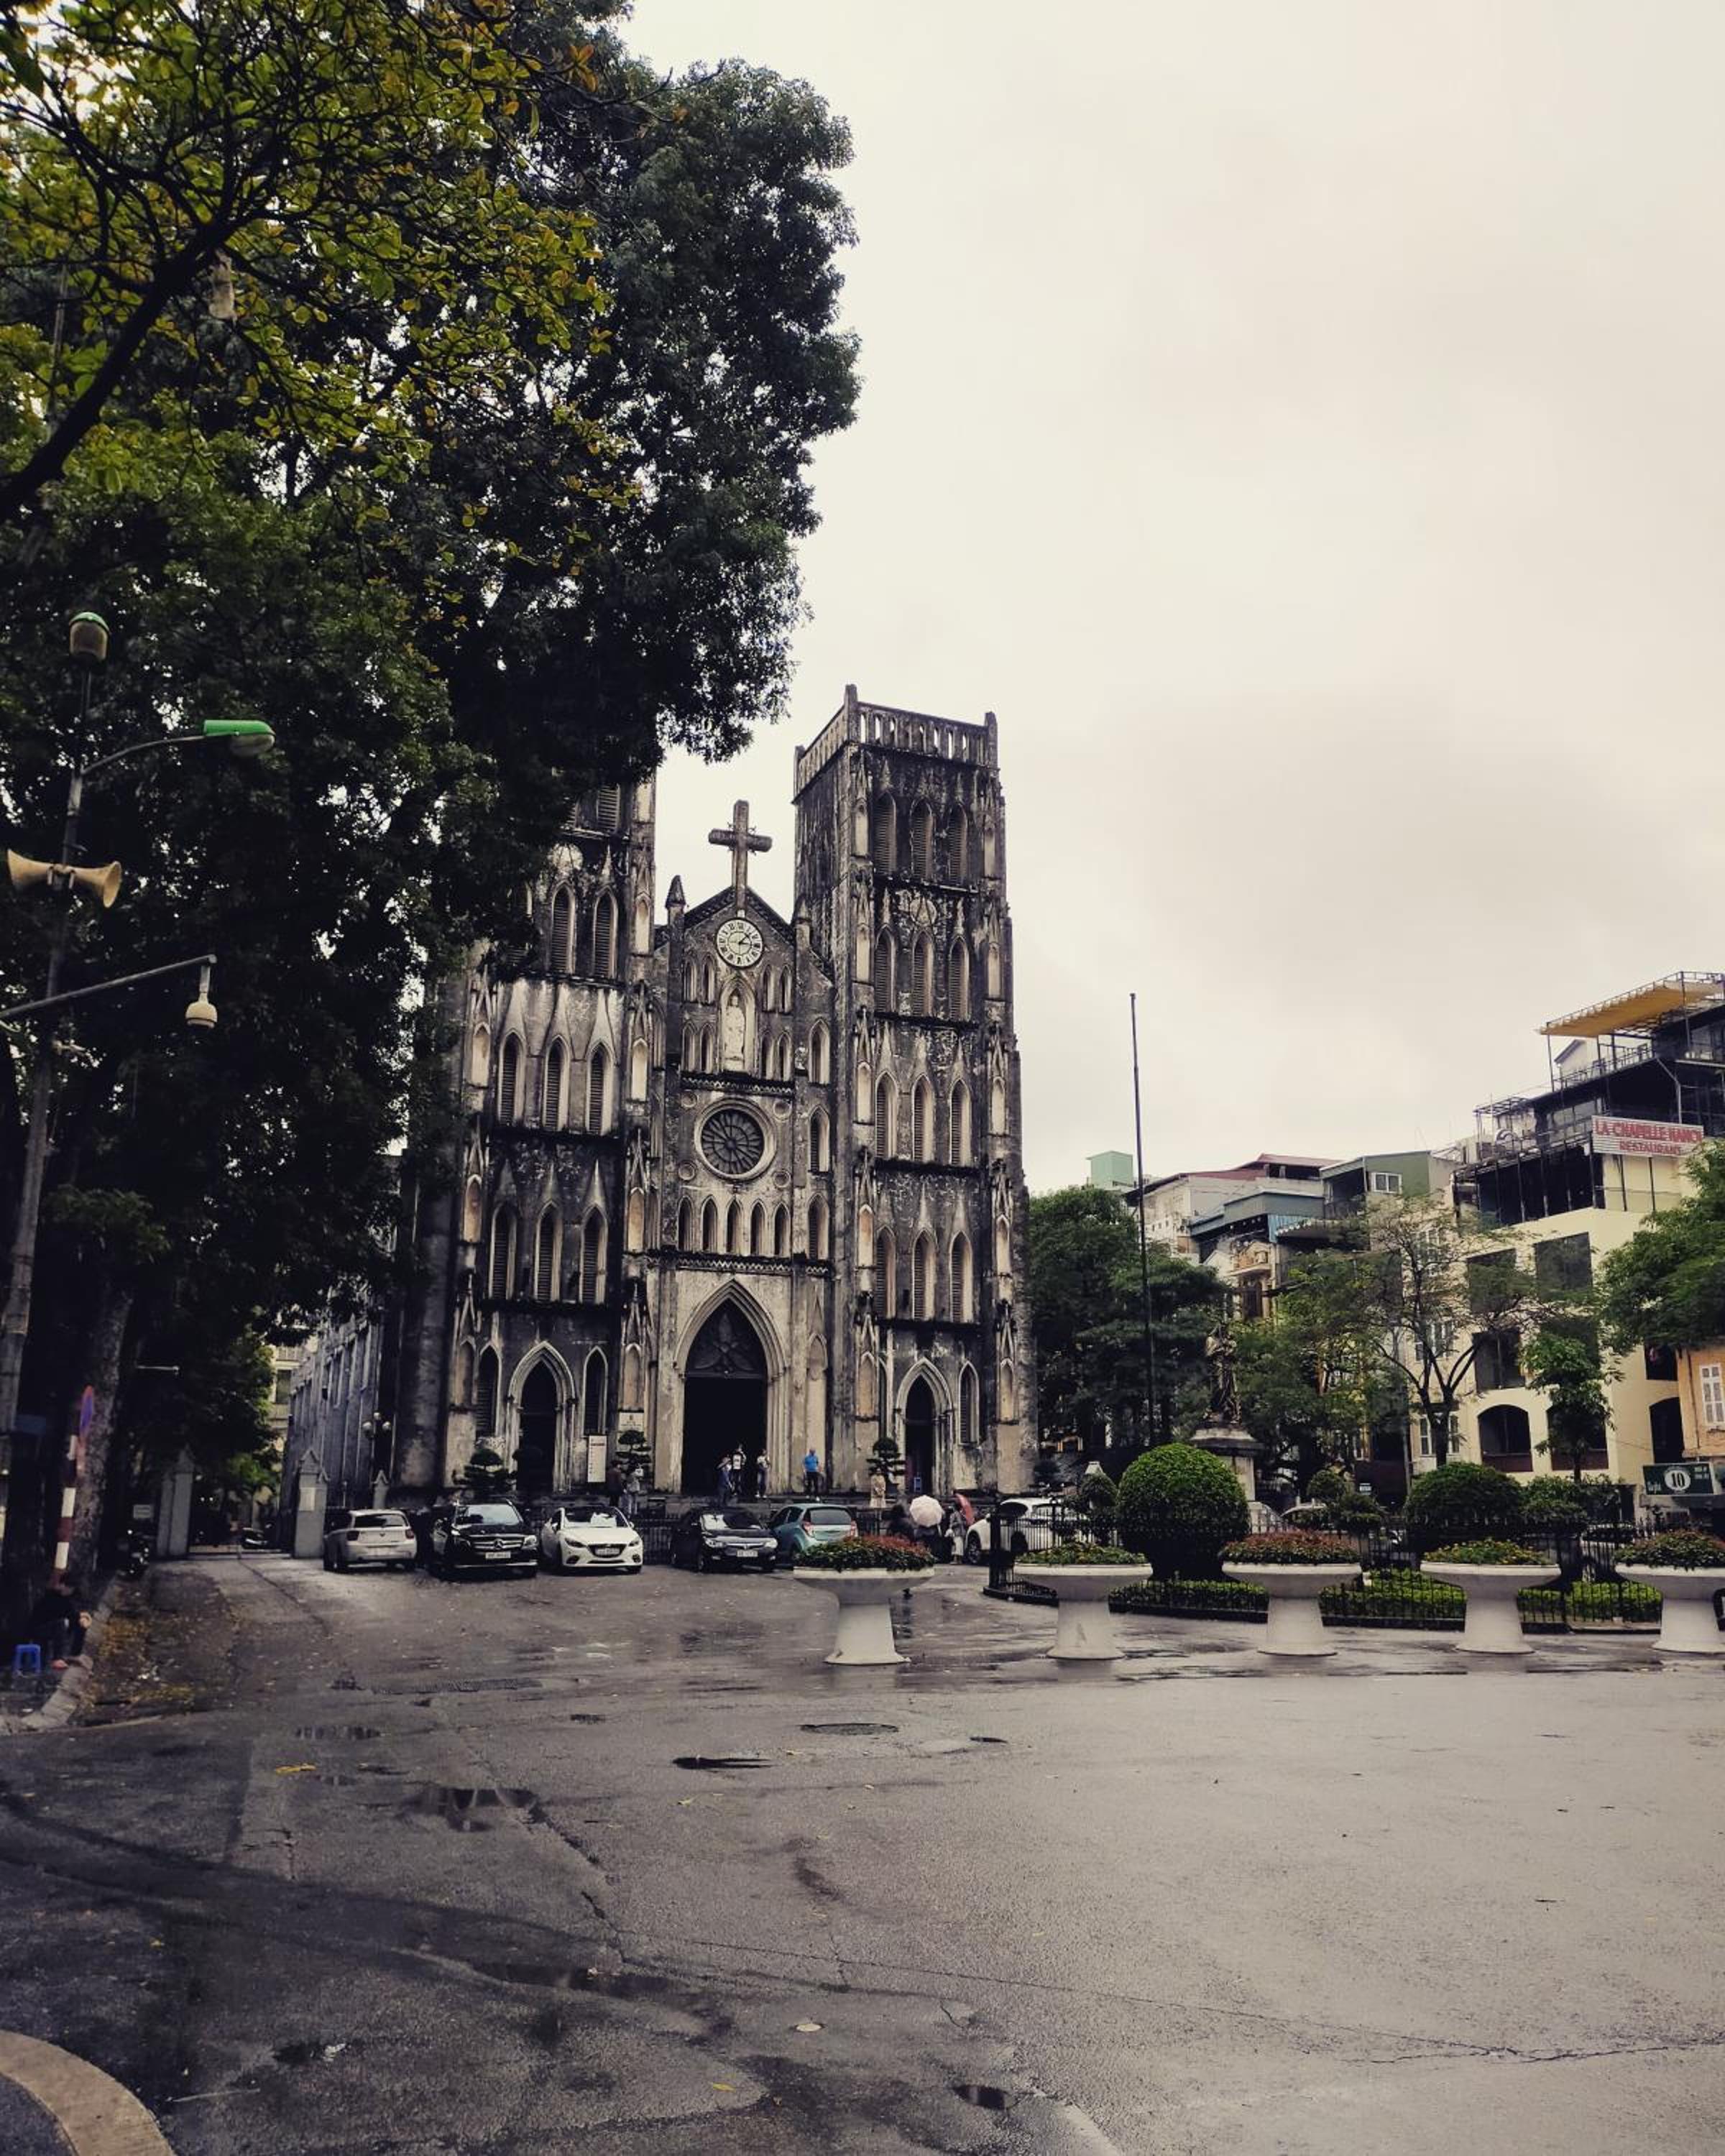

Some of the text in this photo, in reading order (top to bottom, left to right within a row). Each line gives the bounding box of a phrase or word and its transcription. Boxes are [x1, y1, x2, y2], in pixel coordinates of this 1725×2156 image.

[1596, 1120, 1610, 1135] LA
[1612, 1121, 1666, 1141] CHAPELLE
[1619, 1141, 1681, 1154] RESTAURANT
[1671, 1473, 1685, 1488] 10
